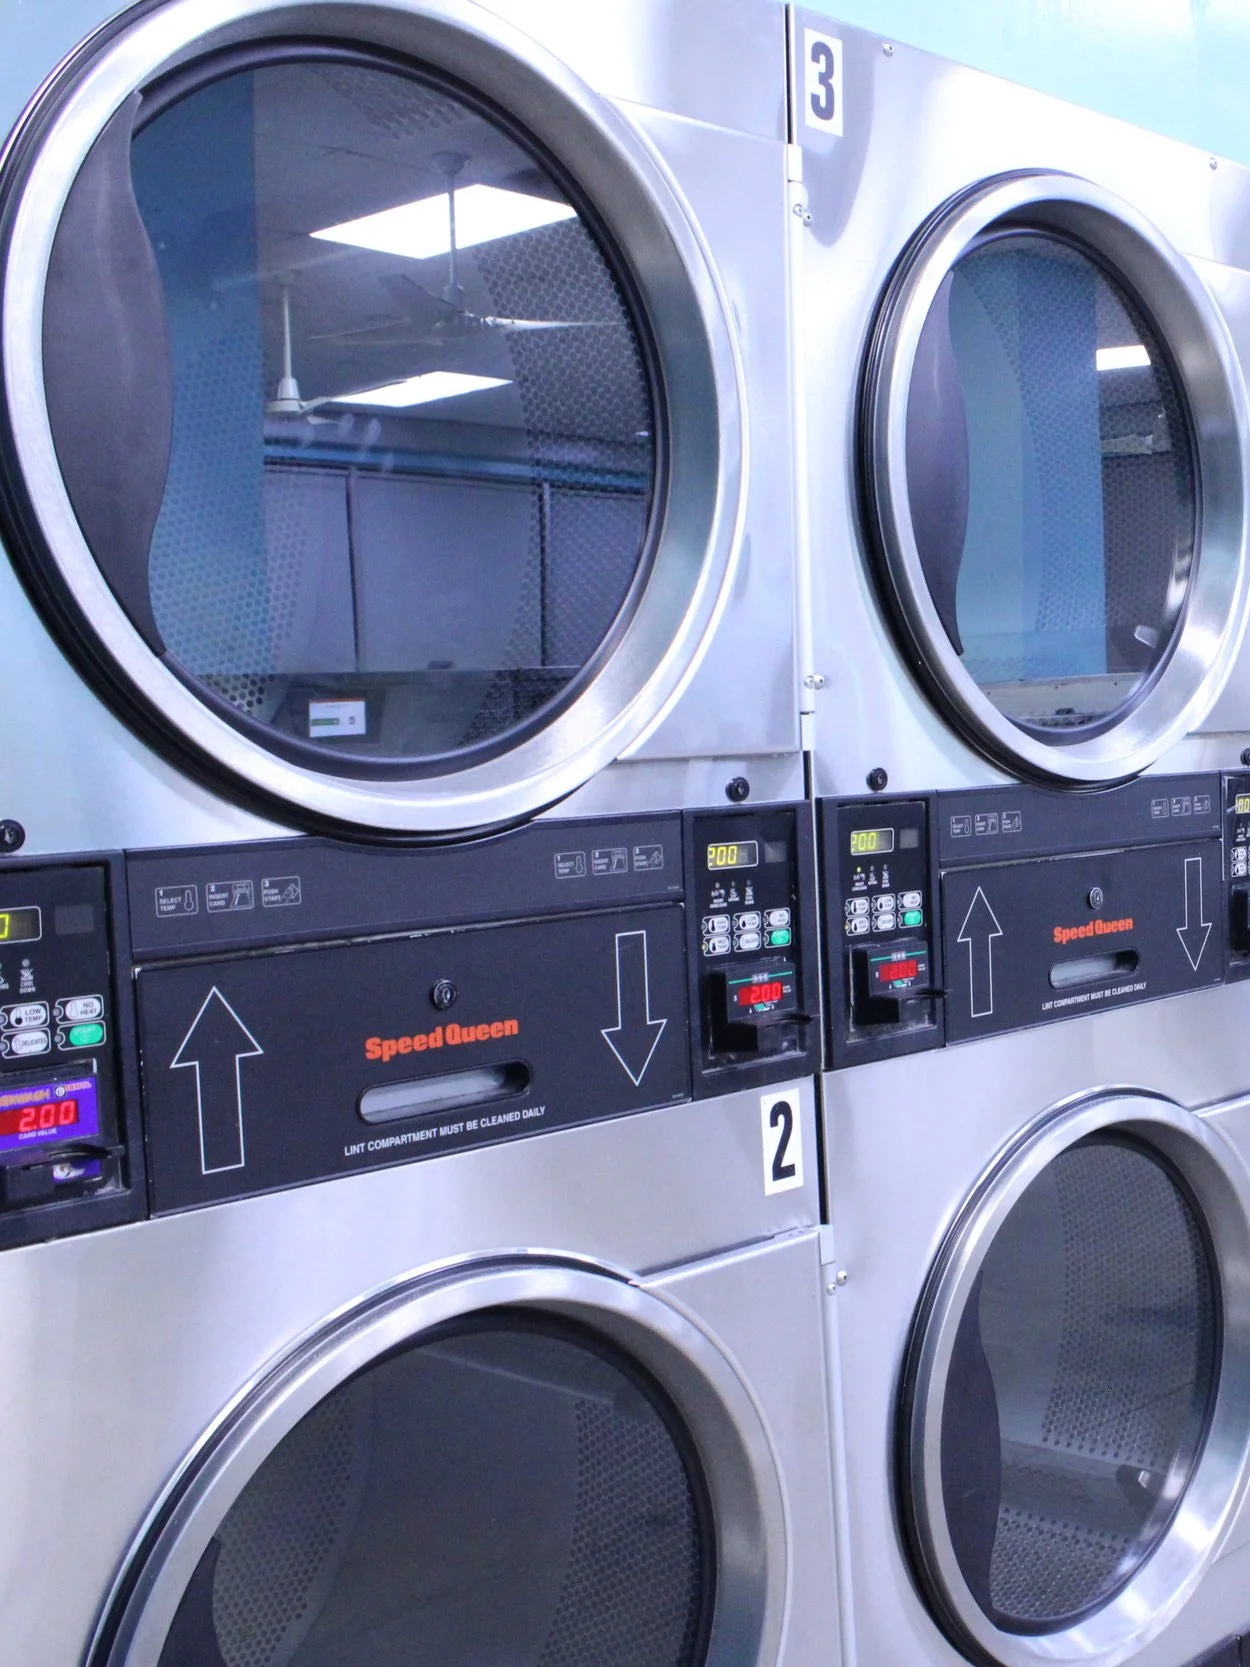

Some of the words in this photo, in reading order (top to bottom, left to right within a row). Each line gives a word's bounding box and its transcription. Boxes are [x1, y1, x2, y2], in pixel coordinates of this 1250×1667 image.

[810, 41, 834, 121] 3
[1053, 920, 1094, 944] Speed
[1094, 917, 1134, 935] Queen
[1041, 1000, 1053, 1010] LINT
[1053, 993, 1091, 1007] COMPARTMENT
[1090, 990, 1104, 1000] MUST
[1104, 988, 1112, 997] BE
[1112, 984, 1134, 996] CLEANED
[1133, 981, 1147, 990] DAILY
[365, 1026, 444, 1062] Speed
[445, 1018, 519, 1046] Queen
[18, 1100, 76, 1132] 2.00
[19, 1130, 37, 1140] CARD
[37, 1127, 57, 1137] VALUE
[344, 1142, 366, 1156] LINT
[367, 1127, 438, 1151] COMPARTMENT
[439, 1122, 464, 1137] MUST
[466, 1120, 479, 1132] BE
[480, 1111, 521, 1128] CLEANED
[522, 1105, 546, 1119] DAILY
[770, 1100, 796, 1182] 2
